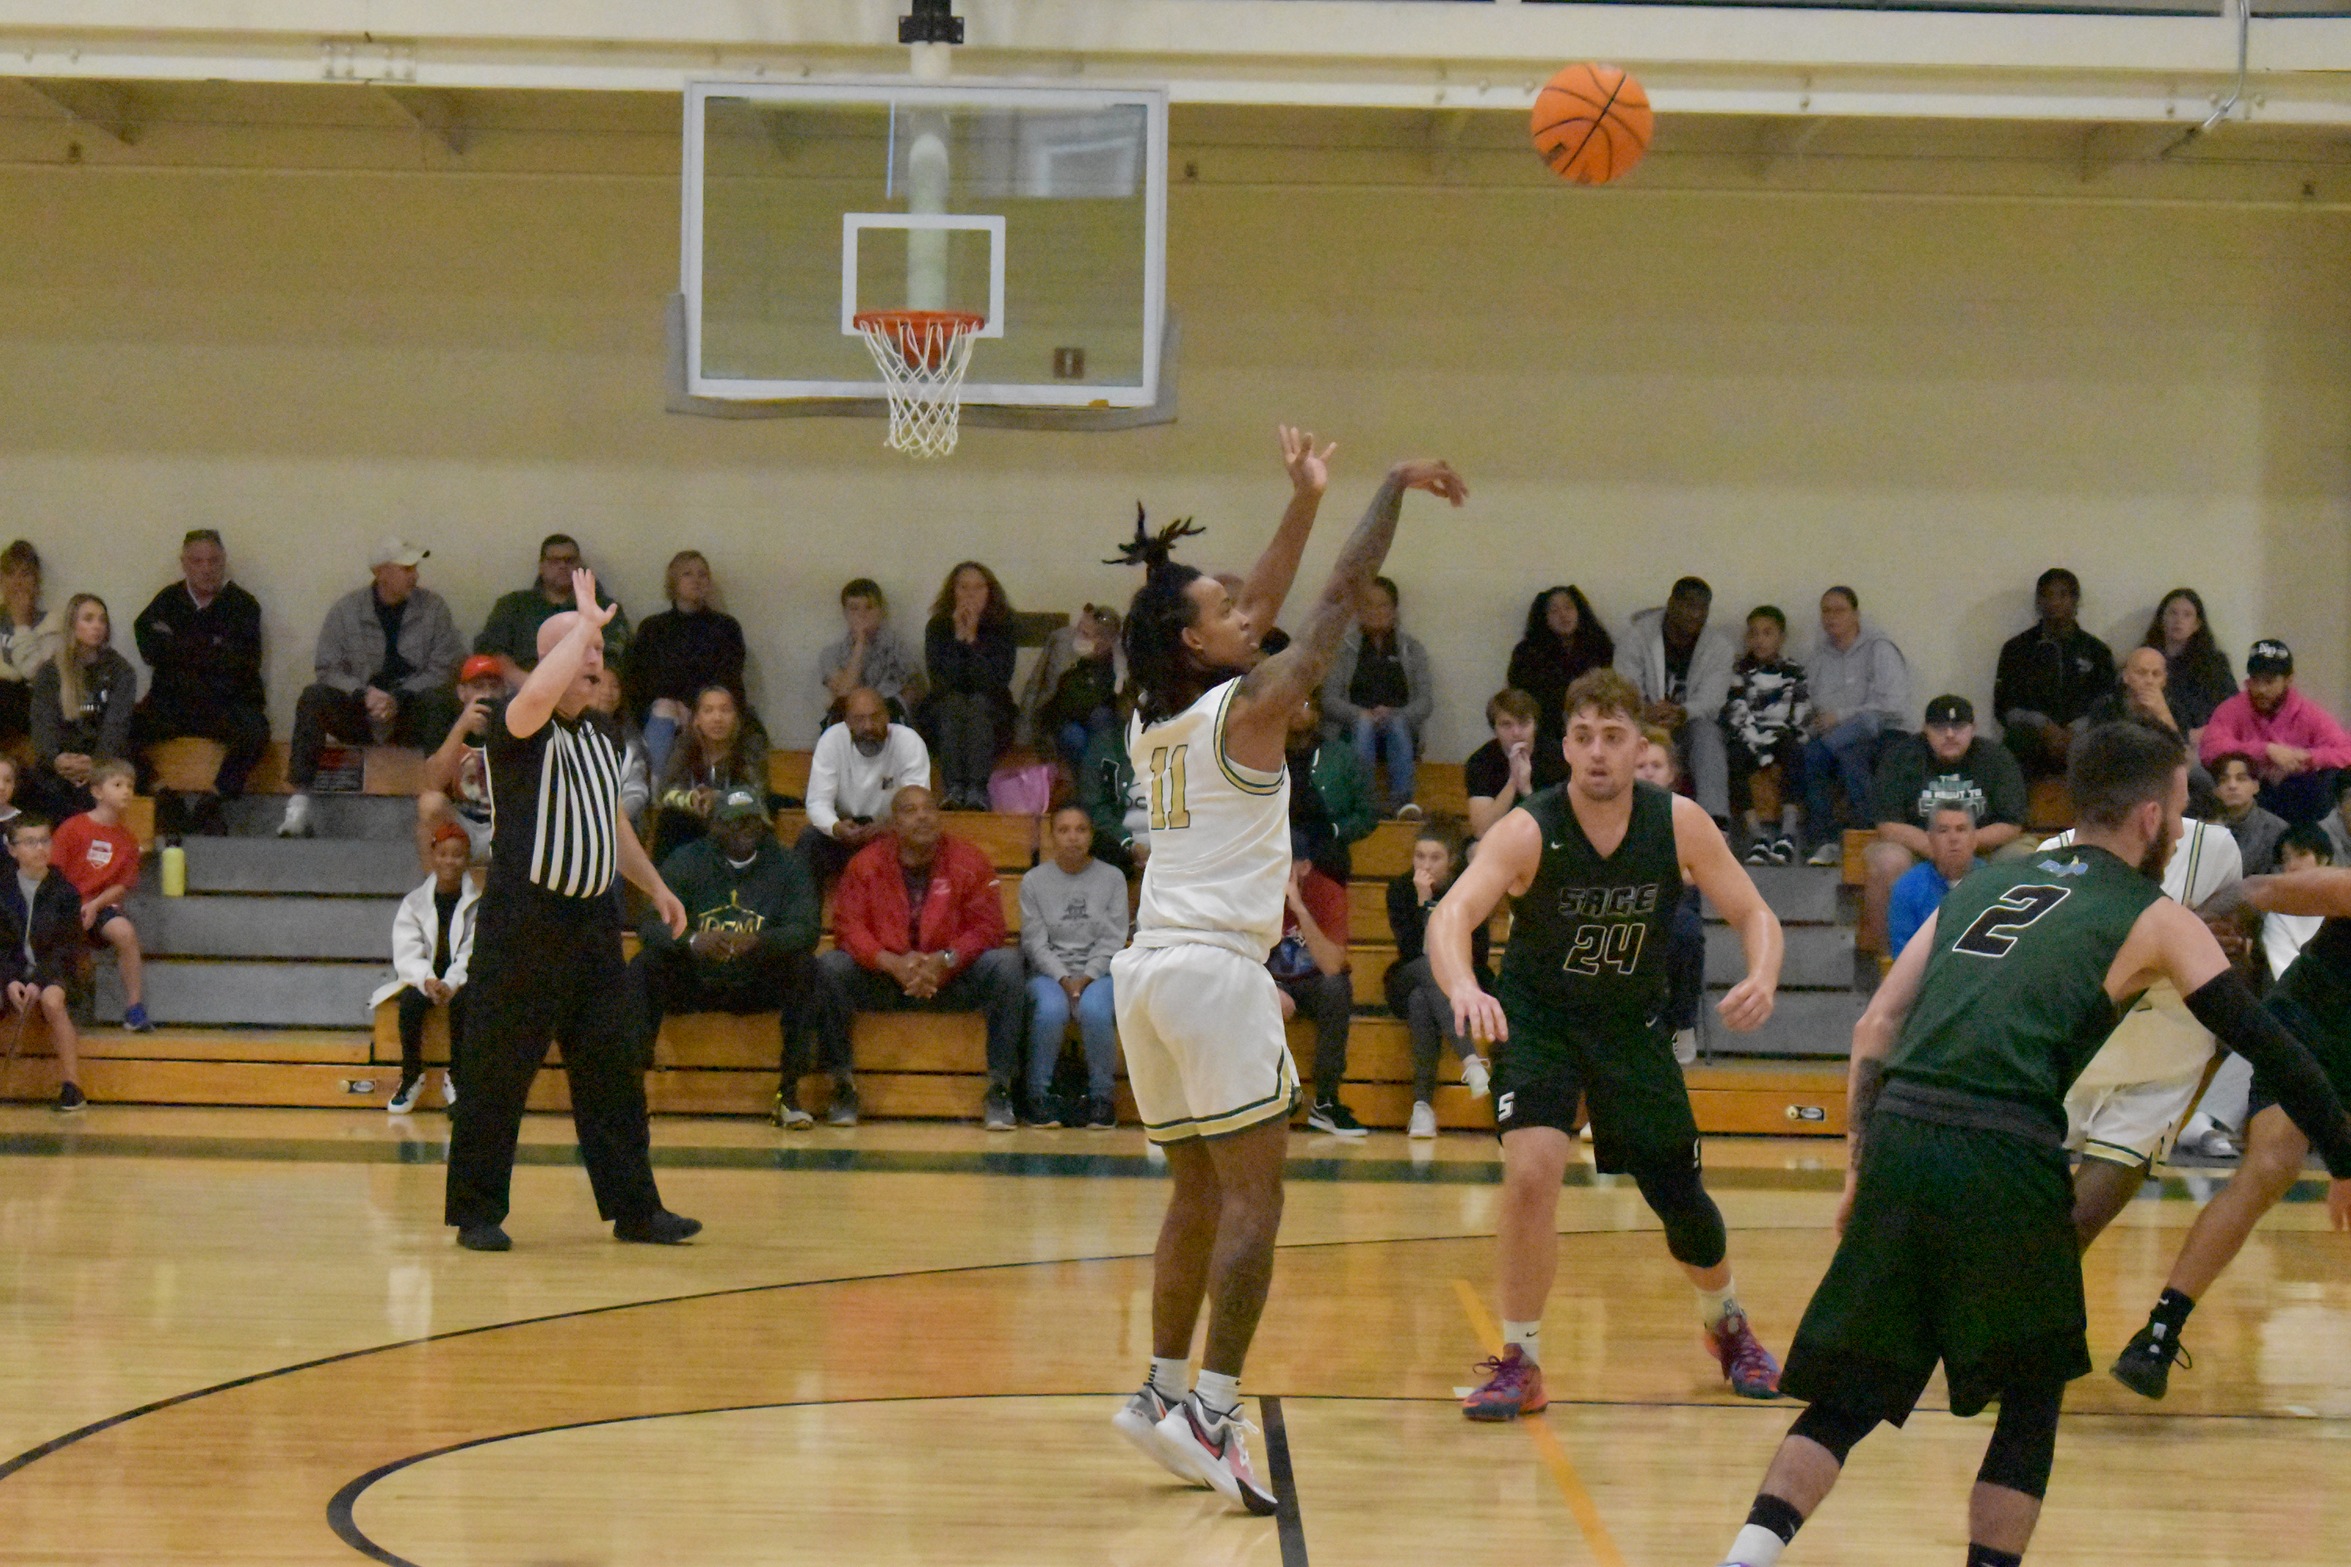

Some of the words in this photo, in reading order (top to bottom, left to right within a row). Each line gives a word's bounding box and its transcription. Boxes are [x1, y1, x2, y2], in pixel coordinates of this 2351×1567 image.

[1149, 744, 1191, 830] 11
[1559, 884, 1659, 918] SAGE
[1952, 884, 2071, 957] 2
[1563, 922, 1646, 976] 24
